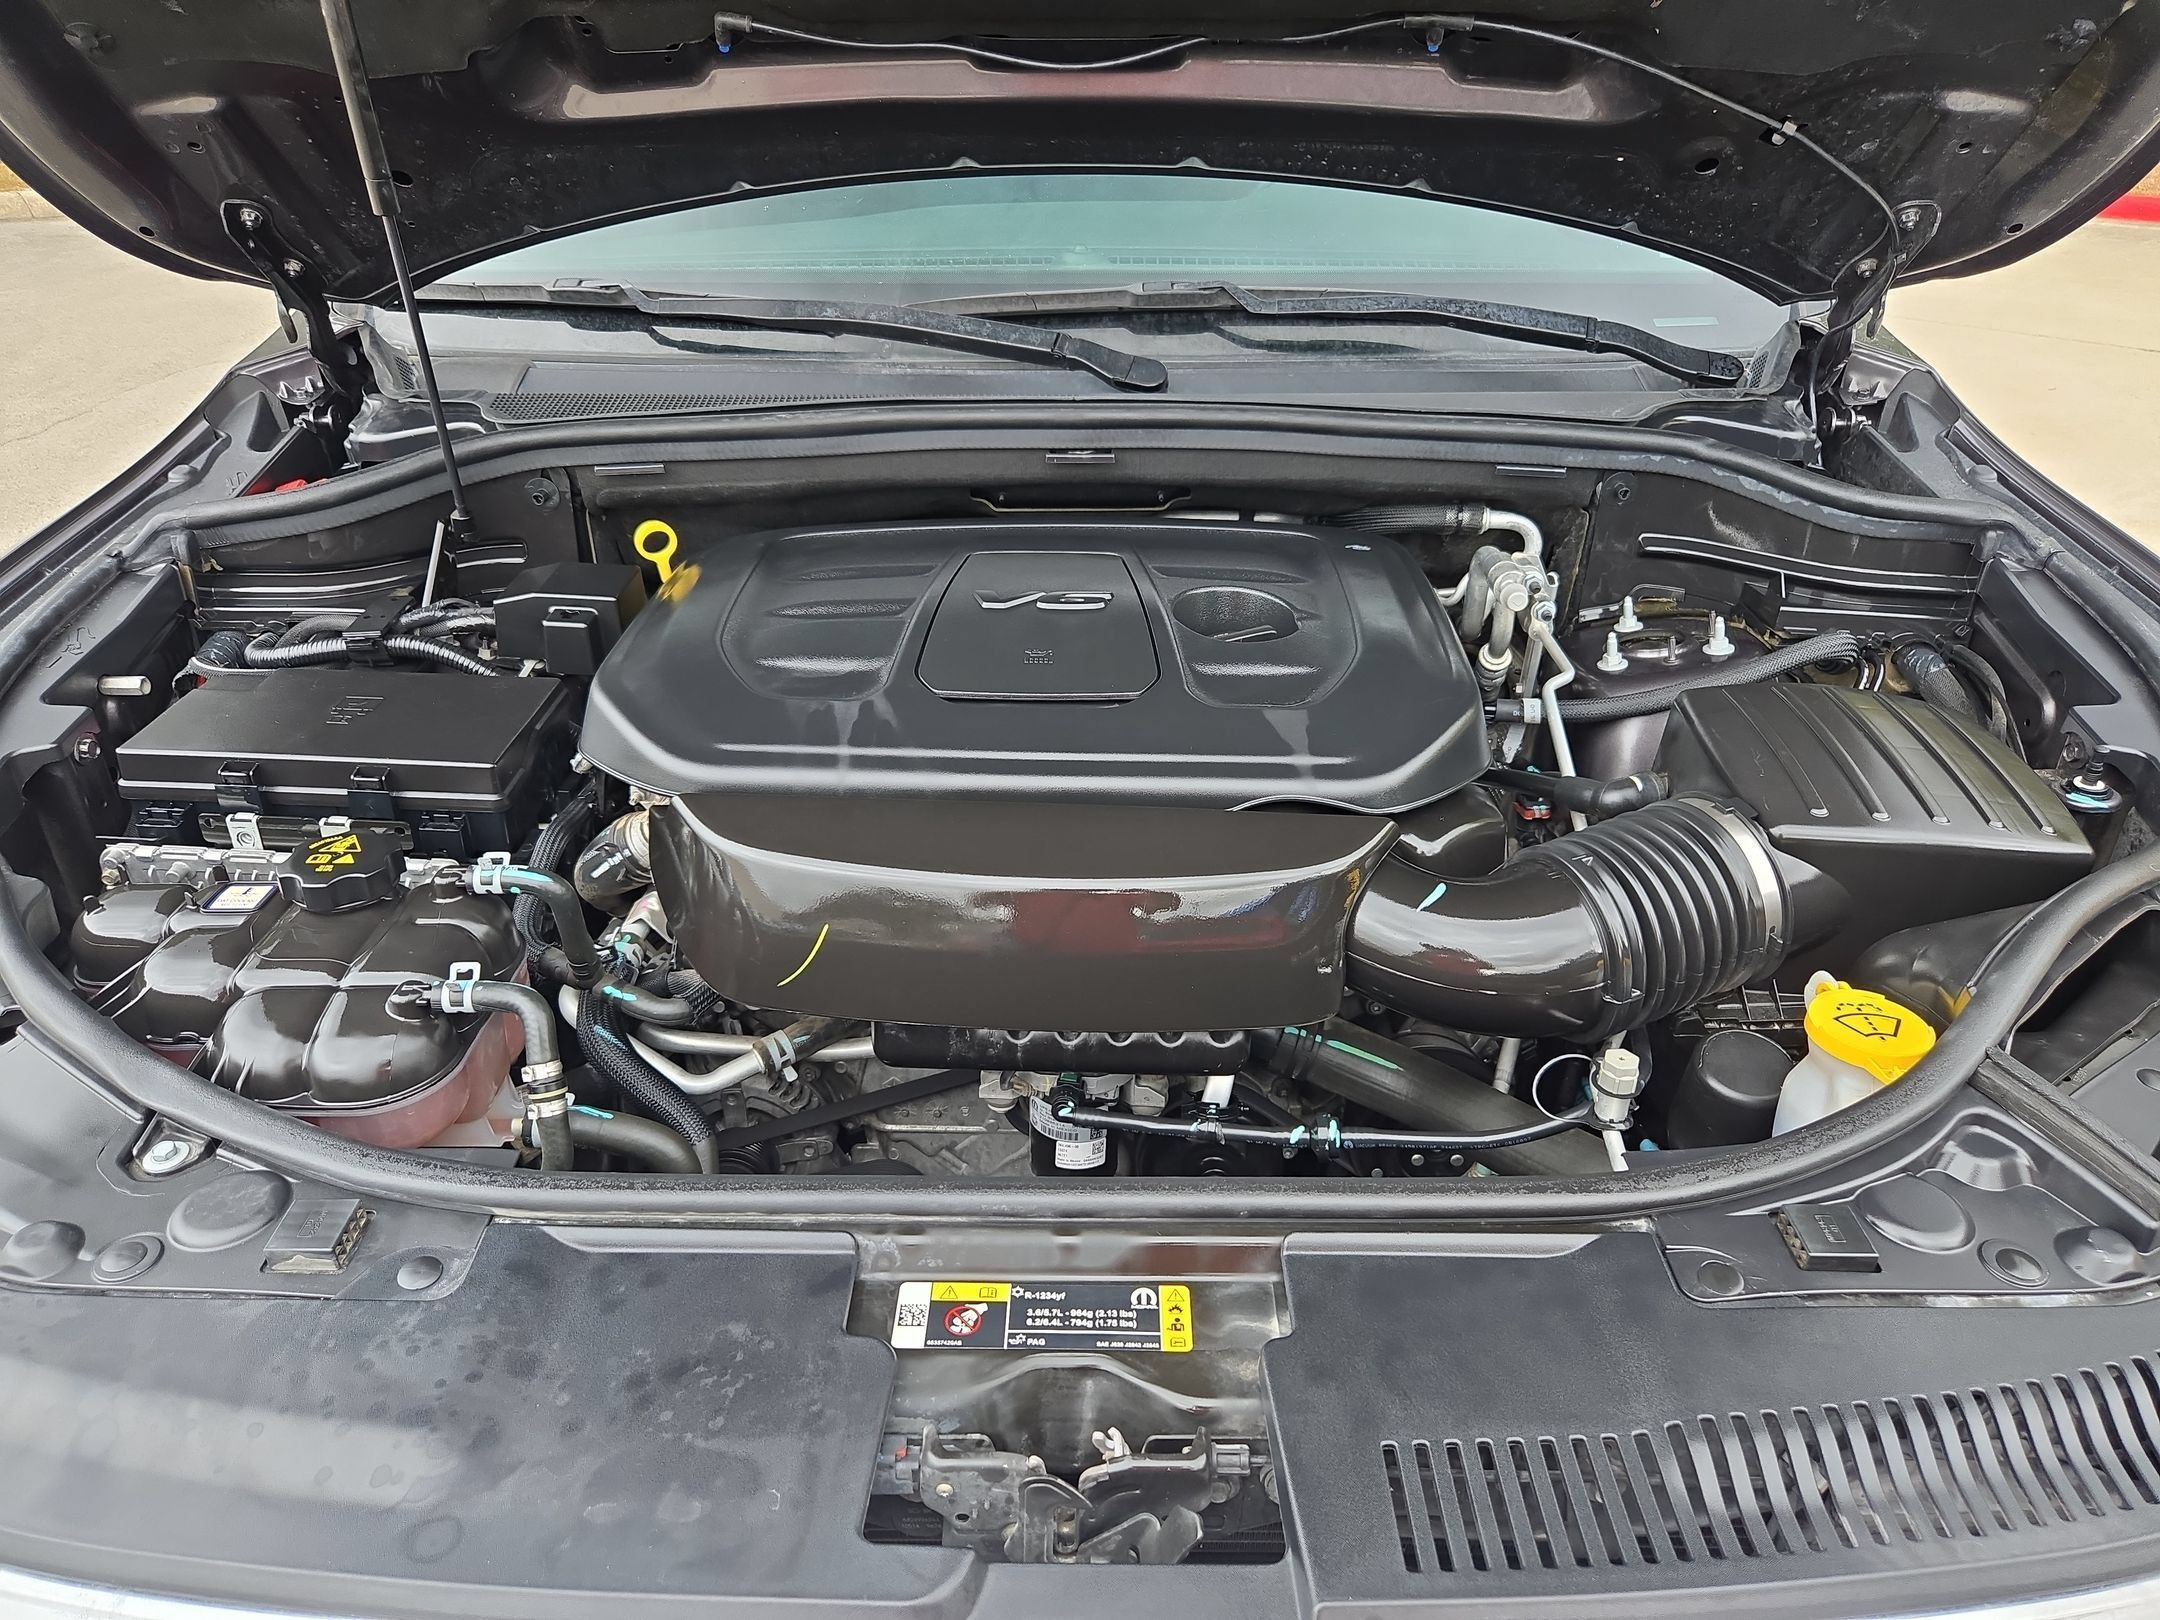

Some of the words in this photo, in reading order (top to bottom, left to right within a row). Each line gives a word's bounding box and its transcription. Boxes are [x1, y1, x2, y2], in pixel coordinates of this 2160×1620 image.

[972, 589, 1114, 610] V6
[1024, 1291, 1066, 1301] R-1234yf
[1095, 1309, 1118, 1319] (2.13
[1119, 1310, 1137, 1319] lbs)
[1070, 1319, 1093, 1328] 794g
[1119, 1319, 1137, 1329] lbs)
[1027, 1338, 1046, 1346] PAG
